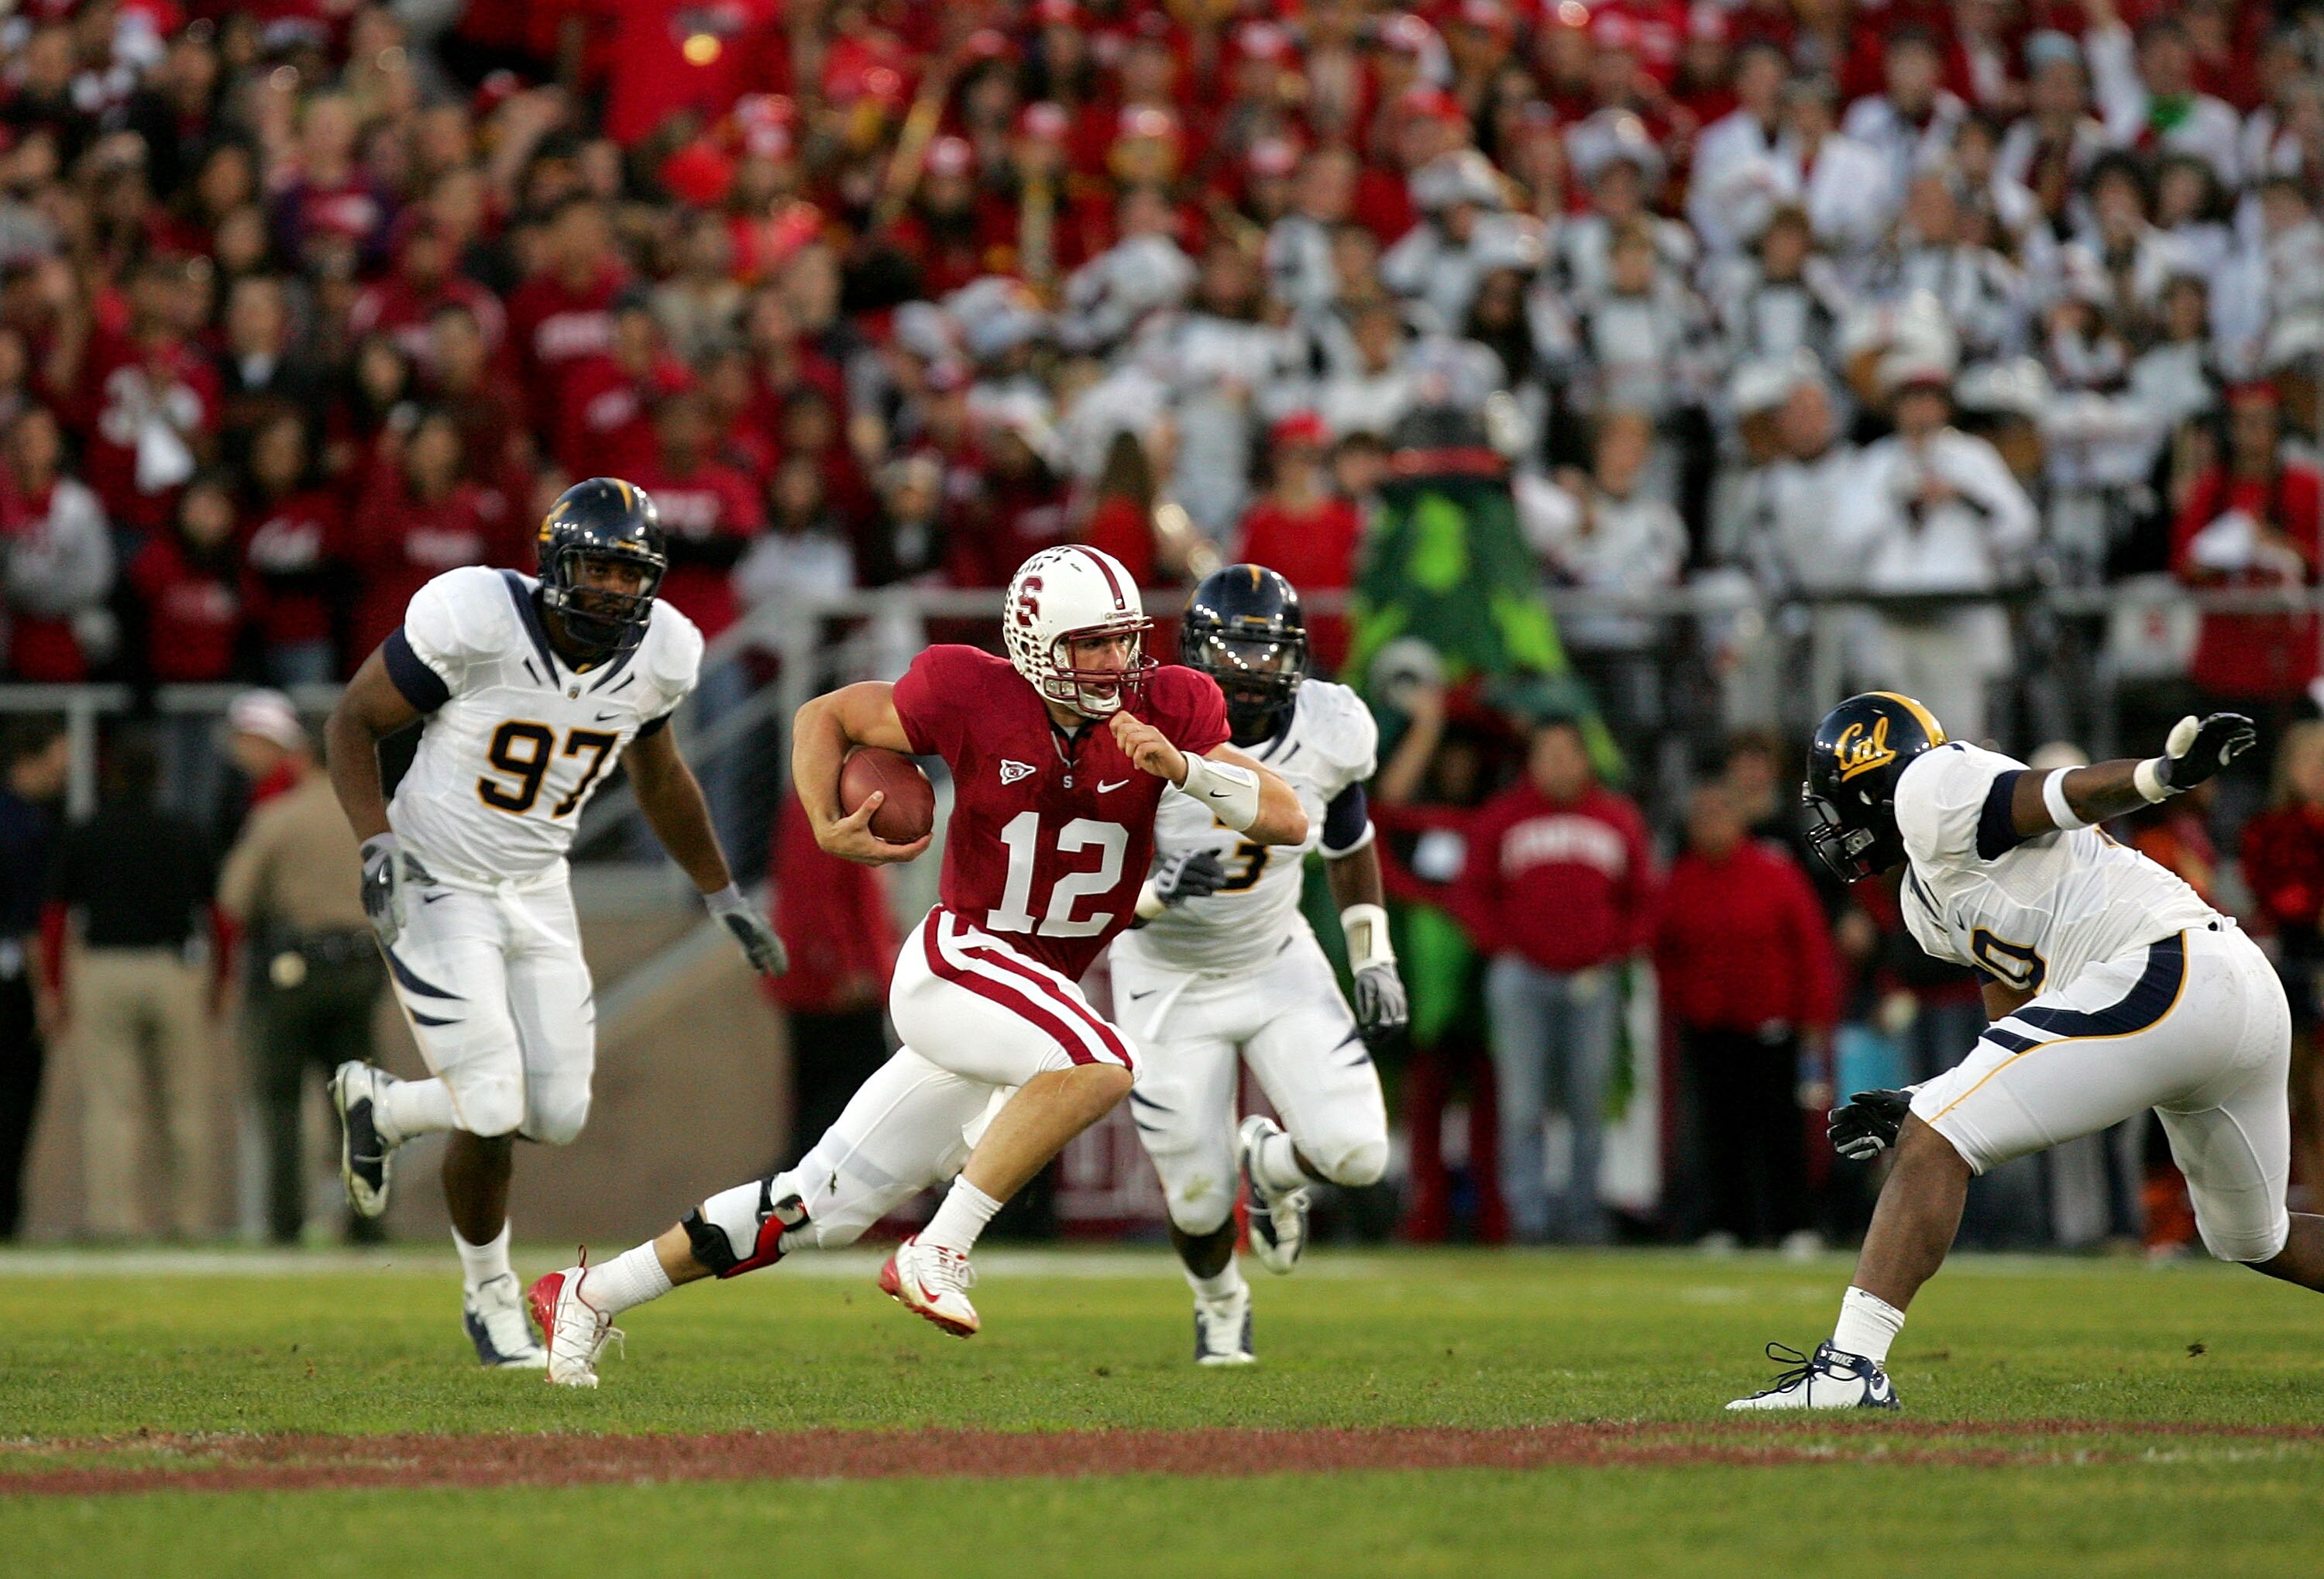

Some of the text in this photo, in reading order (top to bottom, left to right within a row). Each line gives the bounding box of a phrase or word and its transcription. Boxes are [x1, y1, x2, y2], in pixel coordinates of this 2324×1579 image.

[1016, 576, 1044, 628] S
[476, 719, 620, 820] 97
[1834, 717, 1897, 783] Cal
[1063, 775, 1074, 789] S
[986, 811, 1129, 937] 12
[1828, 1350, 1856, 1367] NIKE
